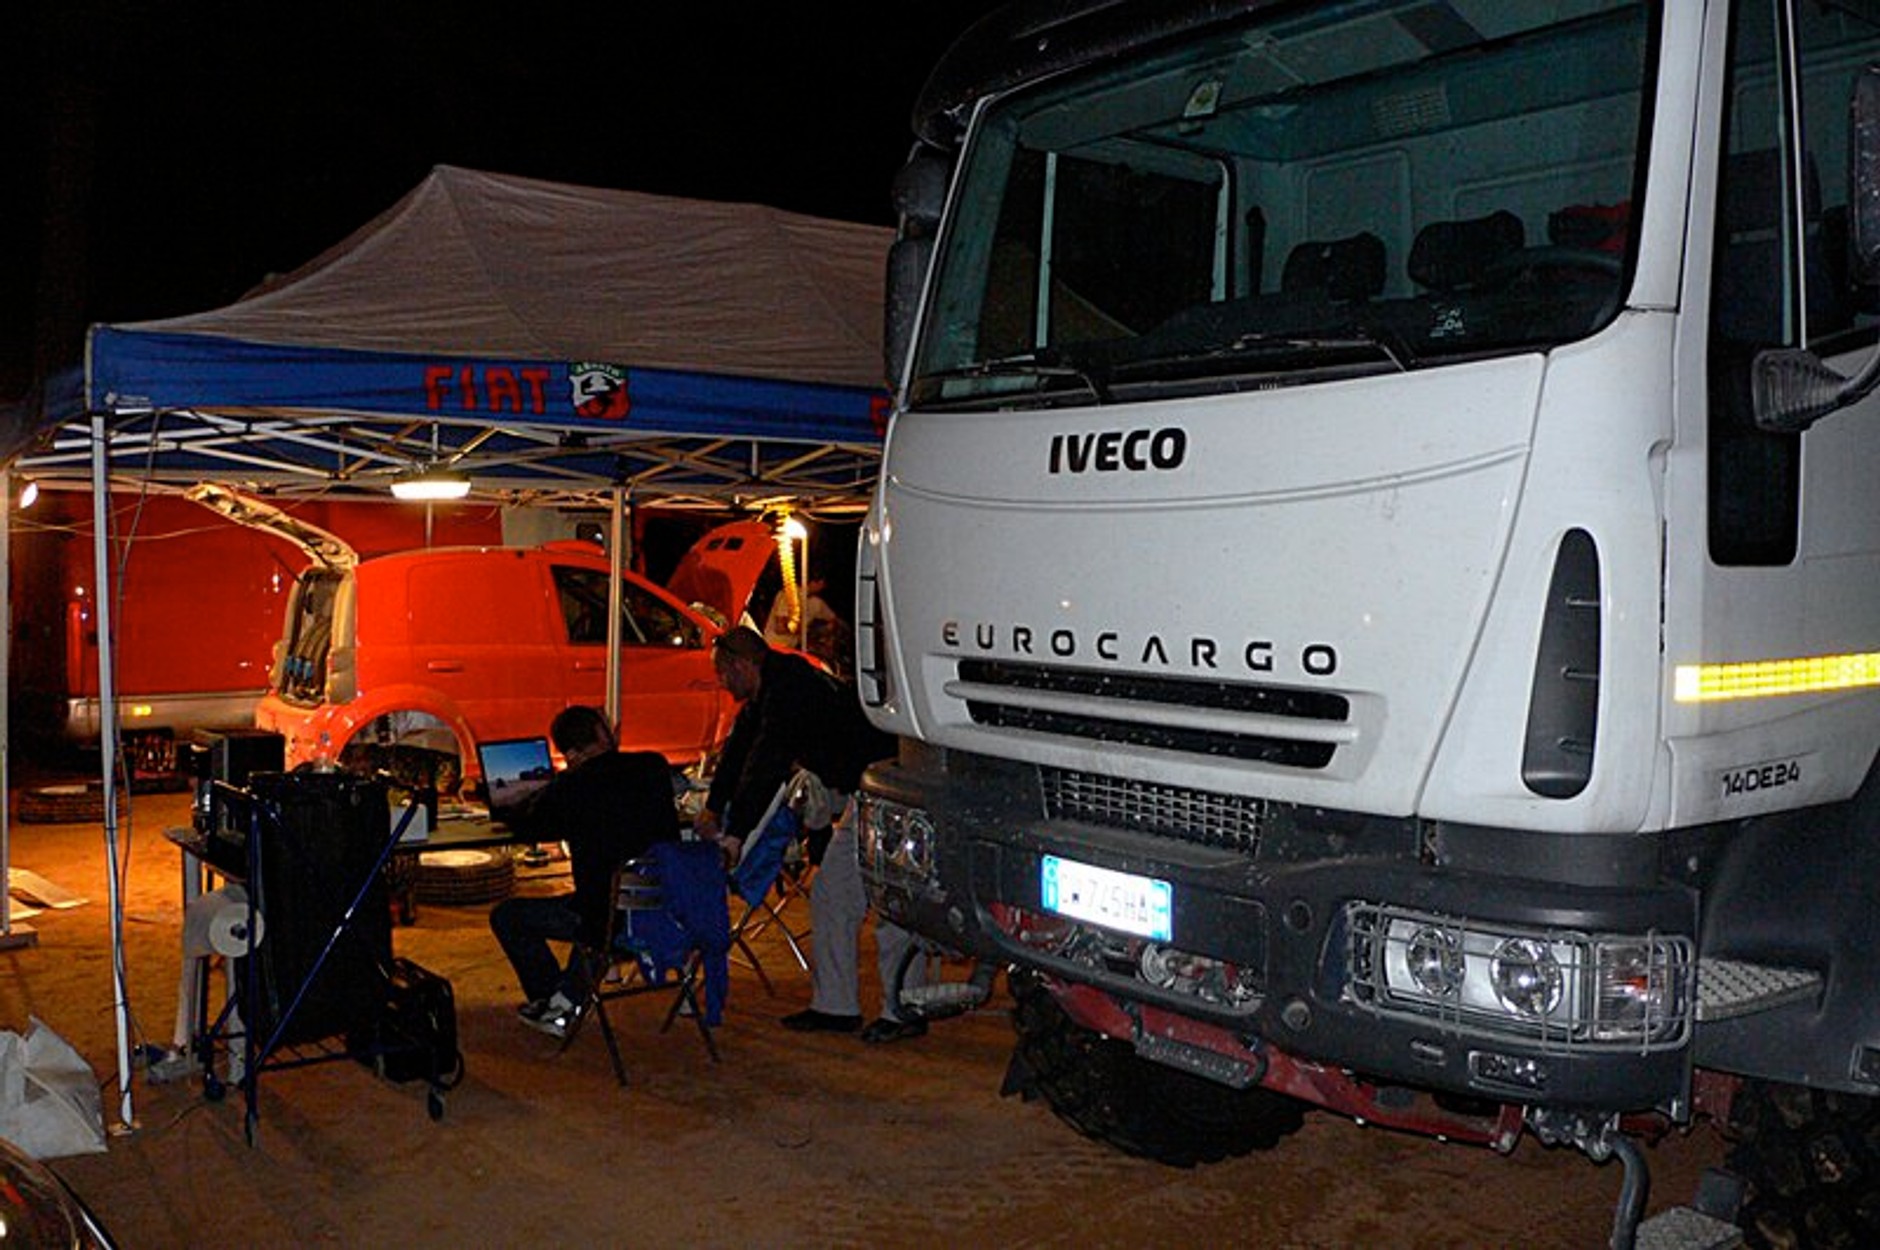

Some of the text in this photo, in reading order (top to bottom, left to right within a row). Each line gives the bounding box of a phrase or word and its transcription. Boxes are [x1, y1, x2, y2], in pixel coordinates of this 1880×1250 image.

[423, 364, 551, 415] FIAT
[1048, 427, 1187, 474] IVECO
[942, 622, 1337, 676] EUROCARGO
